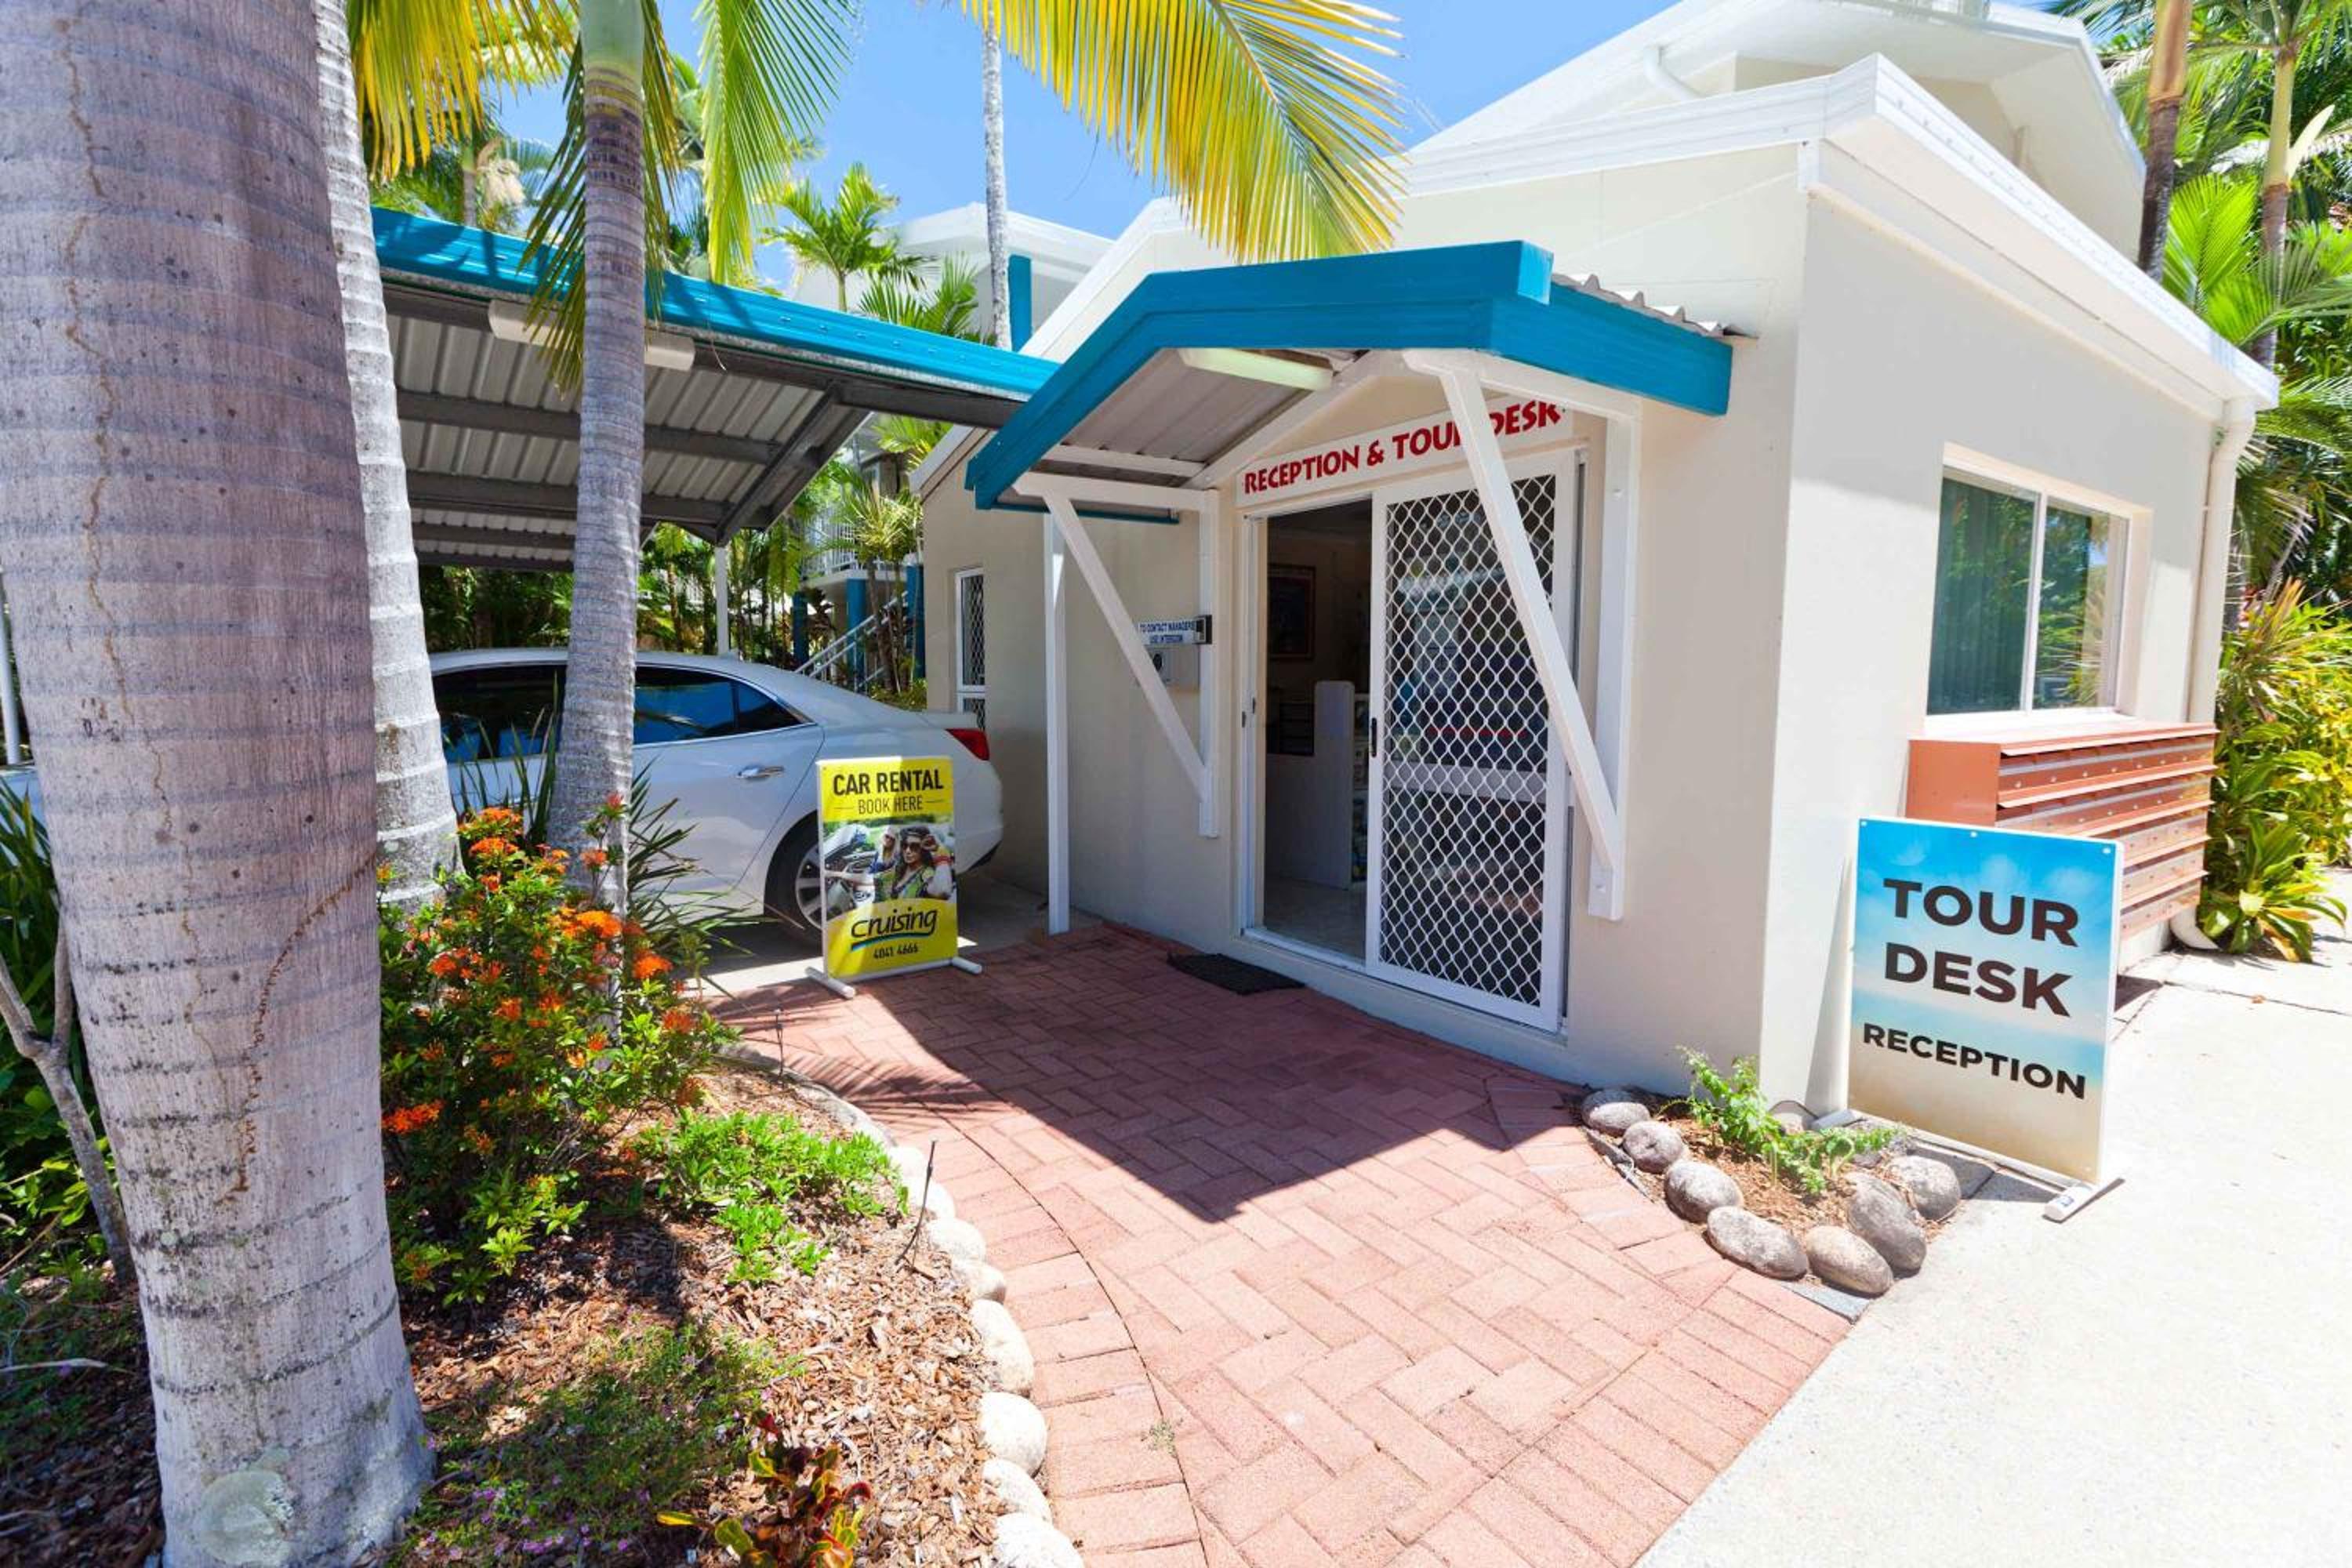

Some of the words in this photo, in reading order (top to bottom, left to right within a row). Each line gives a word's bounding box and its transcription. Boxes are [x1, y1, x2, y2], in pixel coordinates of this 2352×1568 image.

[1244, 445, 1360, 495] RECEPTION
[1367, 440, 1385, 466] &
[833, 773, 871, 797] CAR
[877, 769, 944, 795] RENTAL
[858, 797, 890, 815] BOOK
[894, 795, 923, 812] HERE
[1883, 877, 2079, 947] TOUR
[1884, 942, 2072, 1018] DESK
[1864, 1022, 2085, 1099] RECEPTION
